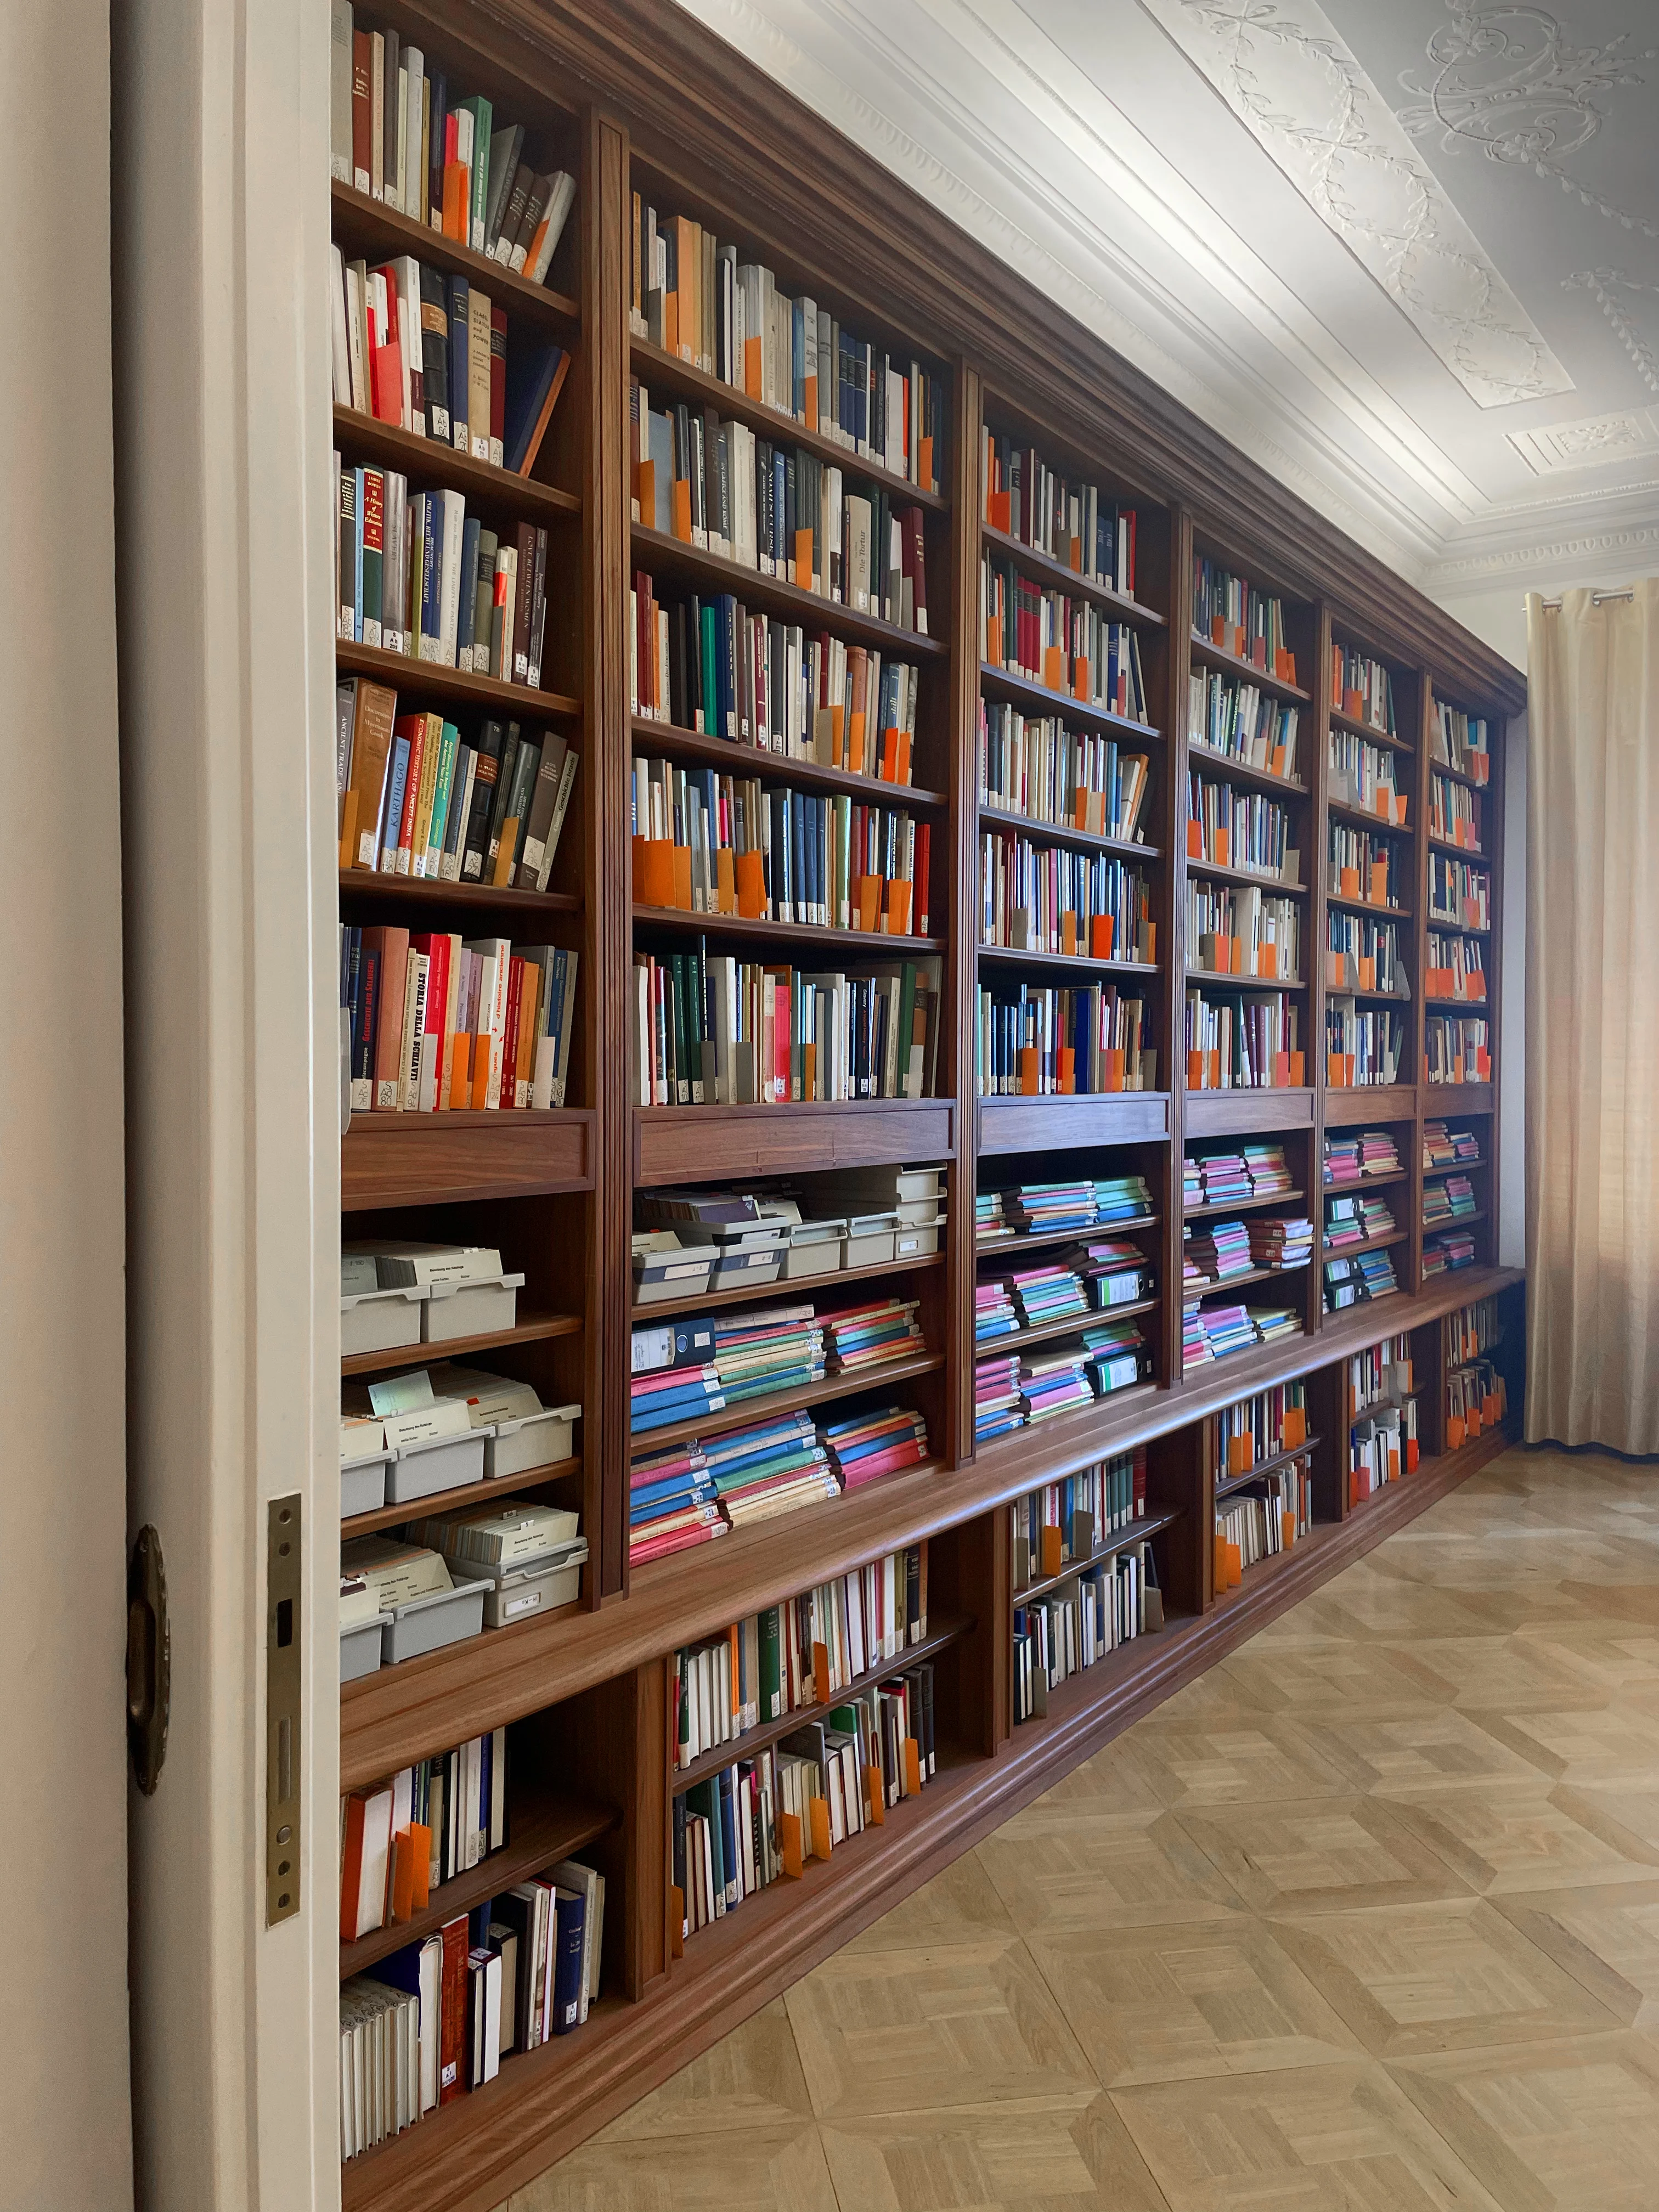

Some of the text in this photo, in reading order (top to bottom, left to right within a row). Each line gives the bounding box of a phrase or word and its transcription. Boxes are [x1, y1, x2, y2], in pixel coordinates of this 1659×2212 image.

[473, 334, 488, 345] POWER
[439, 408, 444, 417] S
[437, 417, 447, 428] Ab
[439, 427, 447, 438] 60
[461, 424, 466, 432] S
[495, 439, 500, 448] S
[345, 607, 349, 616] S
[372, 620, 377, 630] S
[466, 650, 471, 658] S
[481, 645, 486, 654] S
[364, 705, 391, 720] Documents
[339, 715, 348, 748] ANCIENT
[370, 729, 384, 740] Greek
[415, 719, 425, 753] ECONOMIC
[411, 754, 420, 781] HISTORY
[411, 783, 416, 791] OF
[558, 776, 571, 812] Geschichte
[566, 757, 575, 777] Israels
[390, 763, 405, 827] KARTHAGO
[365, 837, 370, 846] S
[534, 840, 538, 848] S
[449, 855, 453, 863] S
[473, 853, 478, 861] S
[526, 855, 538, 867] 235
[365, 959, 375, 991] SKLAVEREI
[413, 973, 426, 1037] STORIA DELLA
[362, 1006, 372, 1041] GESCHICHTE
[446, 1063, 450, 1072] S
[492, 1074, 497, 1082] S
[551, 1077, 556, 1086] S
[362, 1080, 368, 1089] S
[385, 1081, 392, 1090] S
[520, 1081, 524, 1089] S
[380, 1088, 392, 1097] Ad
[381, 1097, 392, 1106] 80
